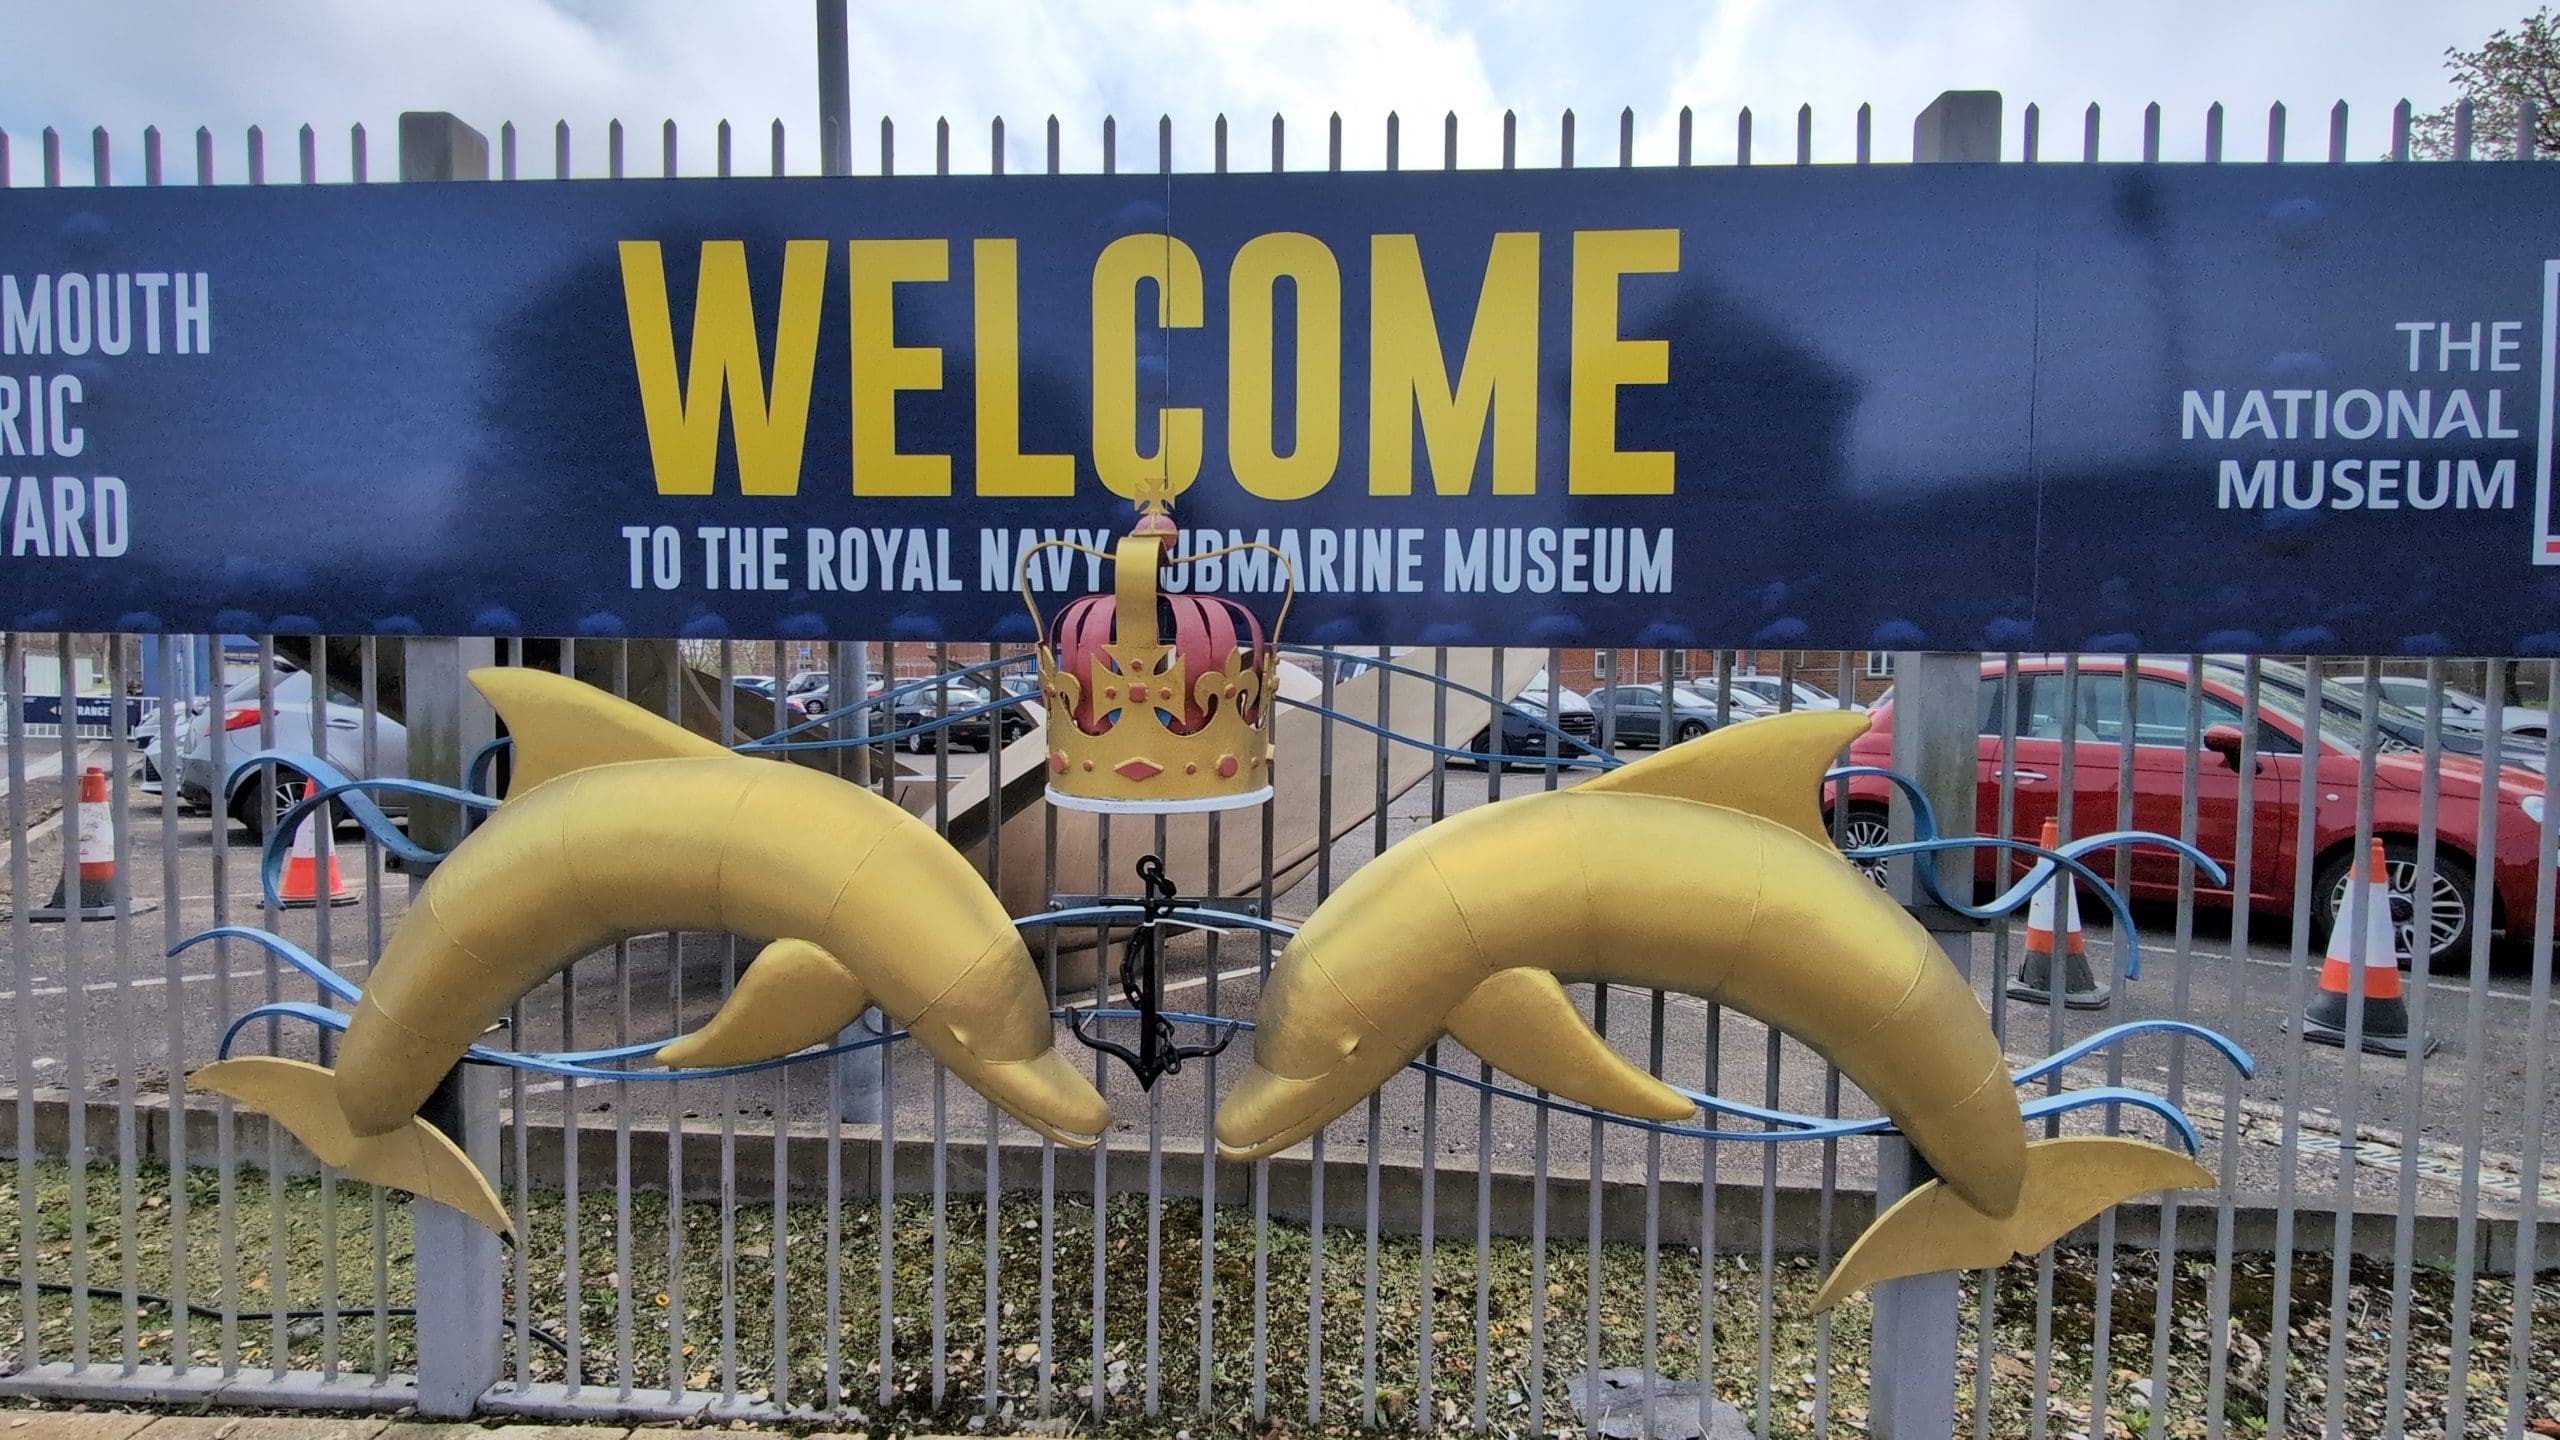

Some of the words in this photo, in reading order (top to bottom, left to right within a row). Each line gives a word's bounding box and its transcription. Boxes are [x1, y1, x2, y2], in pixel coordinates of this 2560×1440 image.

[619, 228, 1681, 502] WELCOME
[2395, 321, 2522, 372] THE
[2182, 389, 2519, 440] NATIONAL
[2217, 459, 2515, 510] MUSEUM
[622, 526, 681, 591] TO
[698, 527, 789, 591] THE
[807, 527, 963, 592] ROYAL
[980, 528, 1110, 593] NAVY
[1160, 528, 1424, 594] UBMARINE
[1443, 527, 1674, 594] MUSEUM
